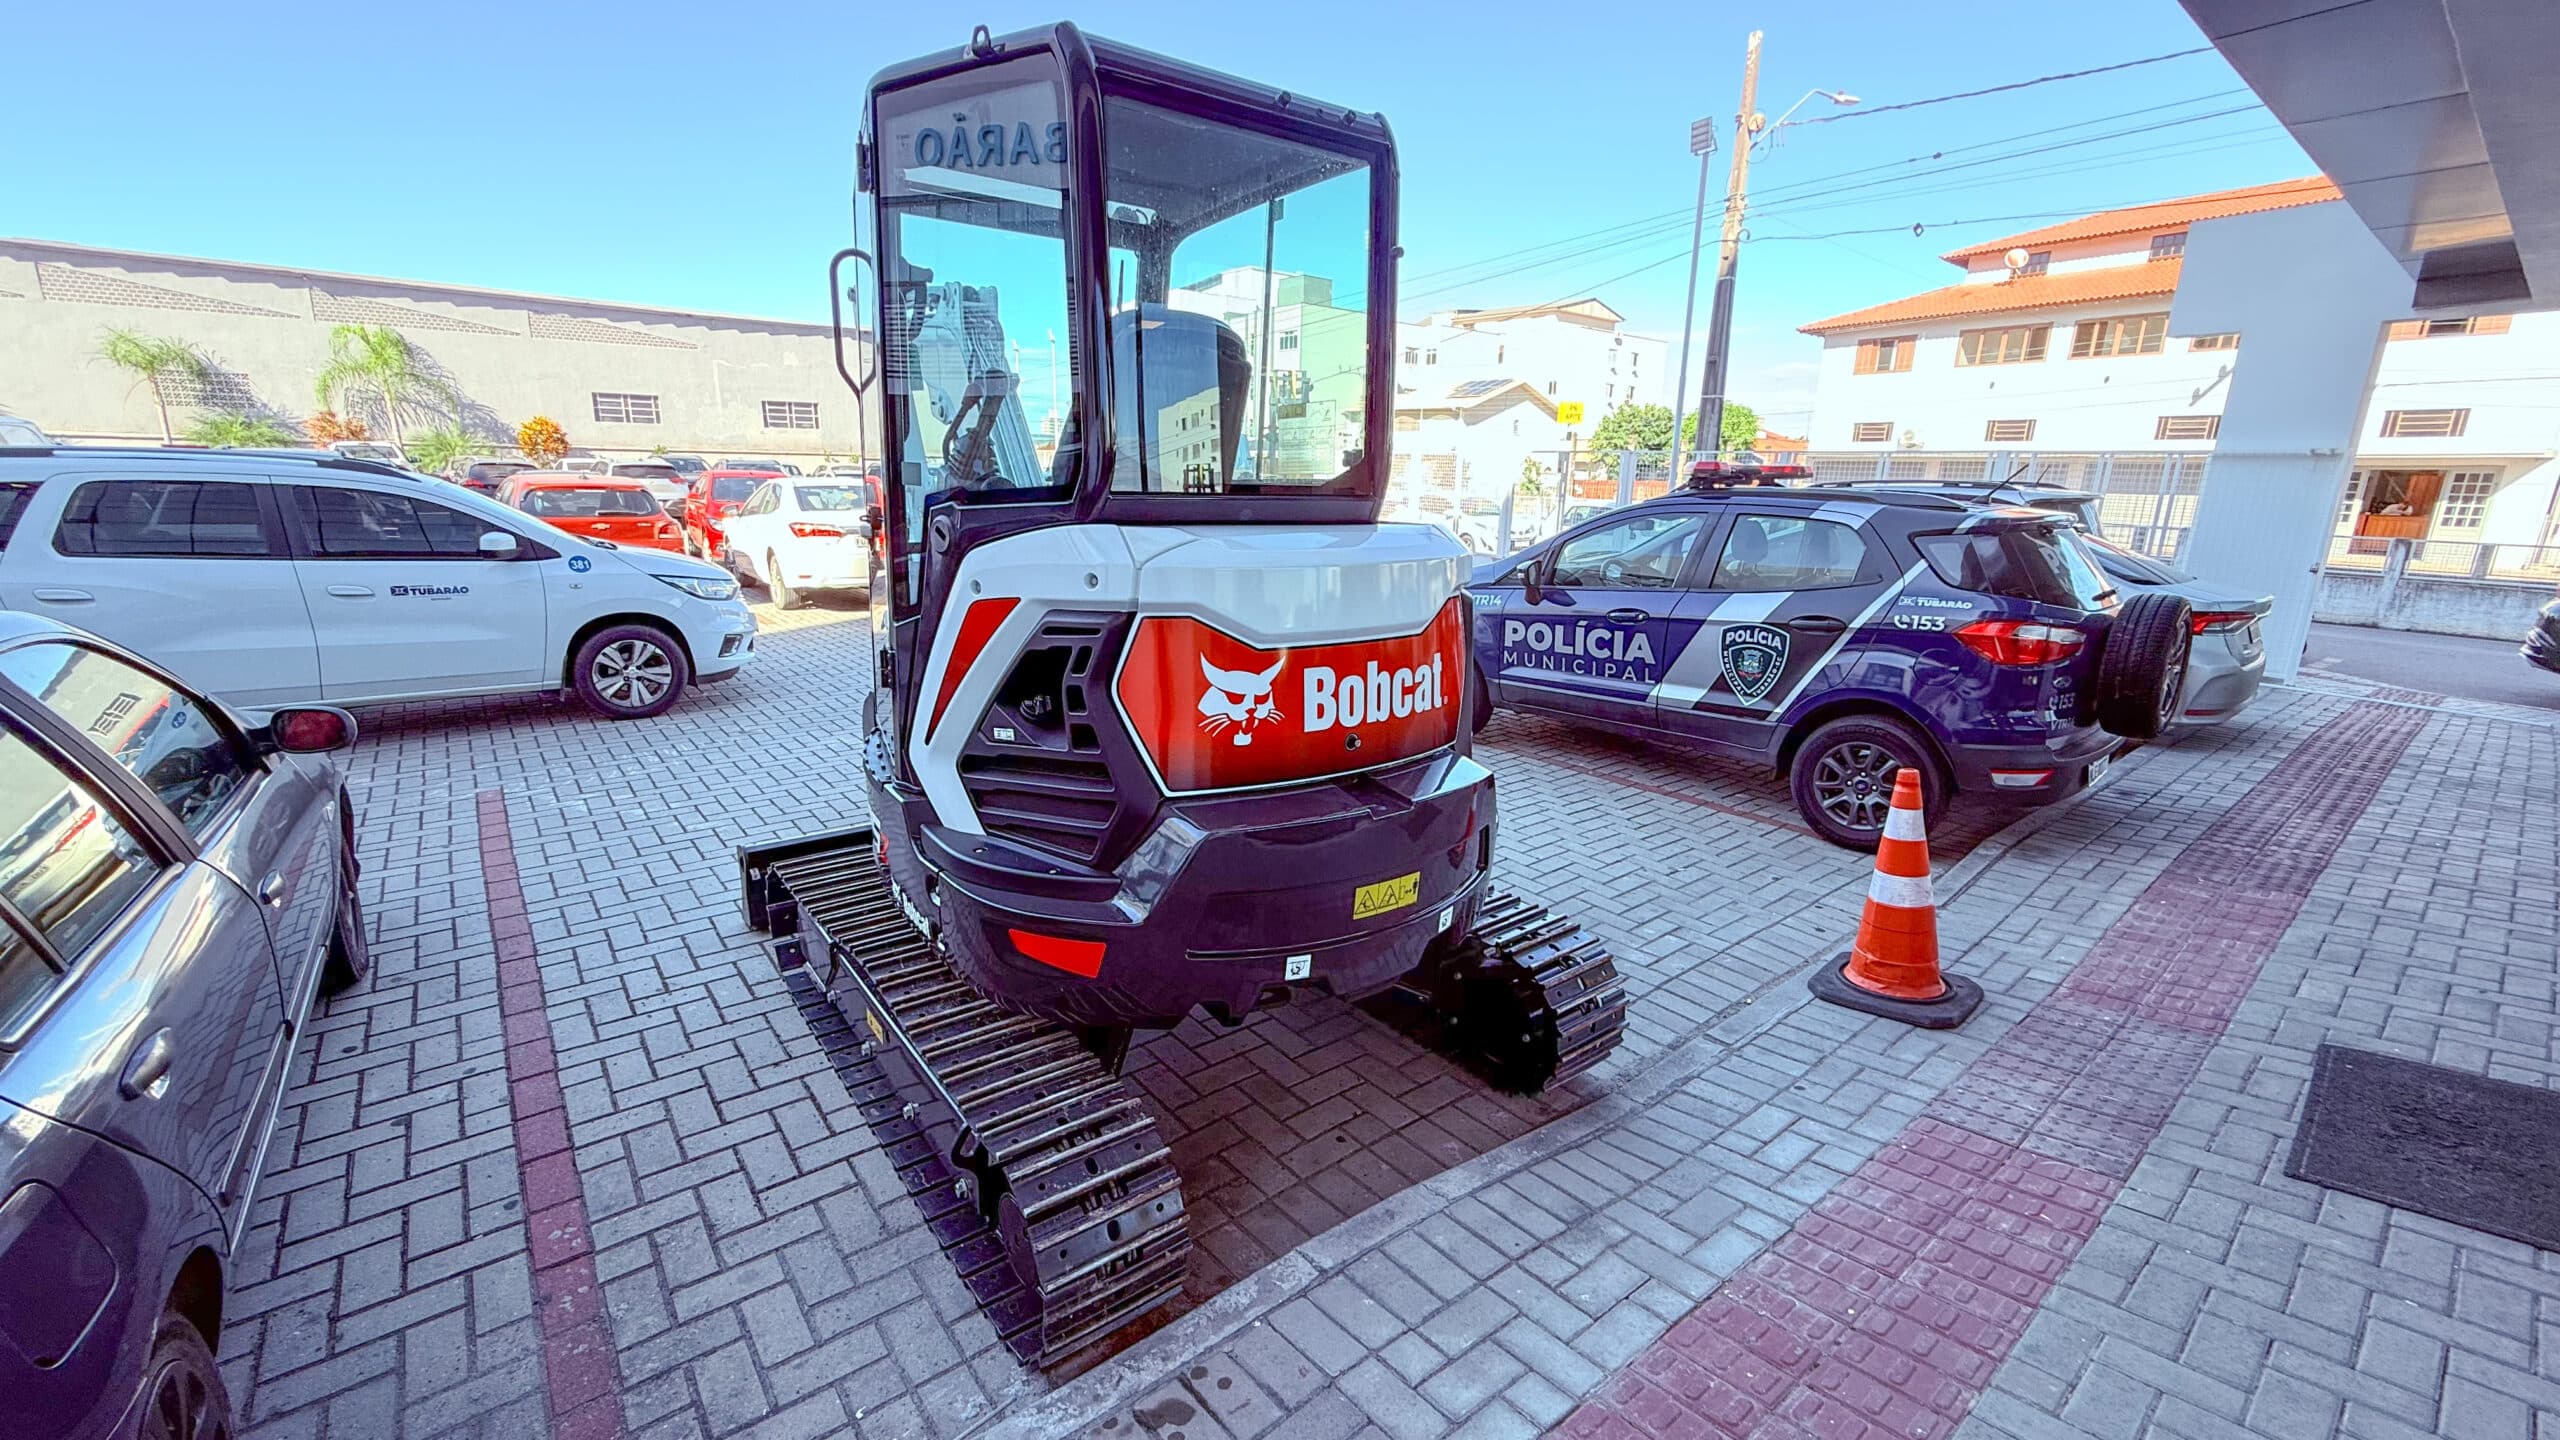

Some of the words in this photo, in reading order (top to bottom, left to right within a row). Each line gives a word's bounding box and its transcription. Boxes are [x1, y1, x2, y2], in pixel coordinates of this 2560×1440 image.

[570, 560, 590, 570] 381
[409, 585, 470, 596] TUBARÃO
[1917, 599, 1973, 609] TUBARÃO
[1911, 615, 1946, 631] 153
[1503, 619, 1656, 665] POLÍCIA
[1725, 628, 1782, 651] POLÍCIA
[1503, 651, 1656, 684] MUNICIPAL
[1303, 652, 1443, 733] Bobcat
